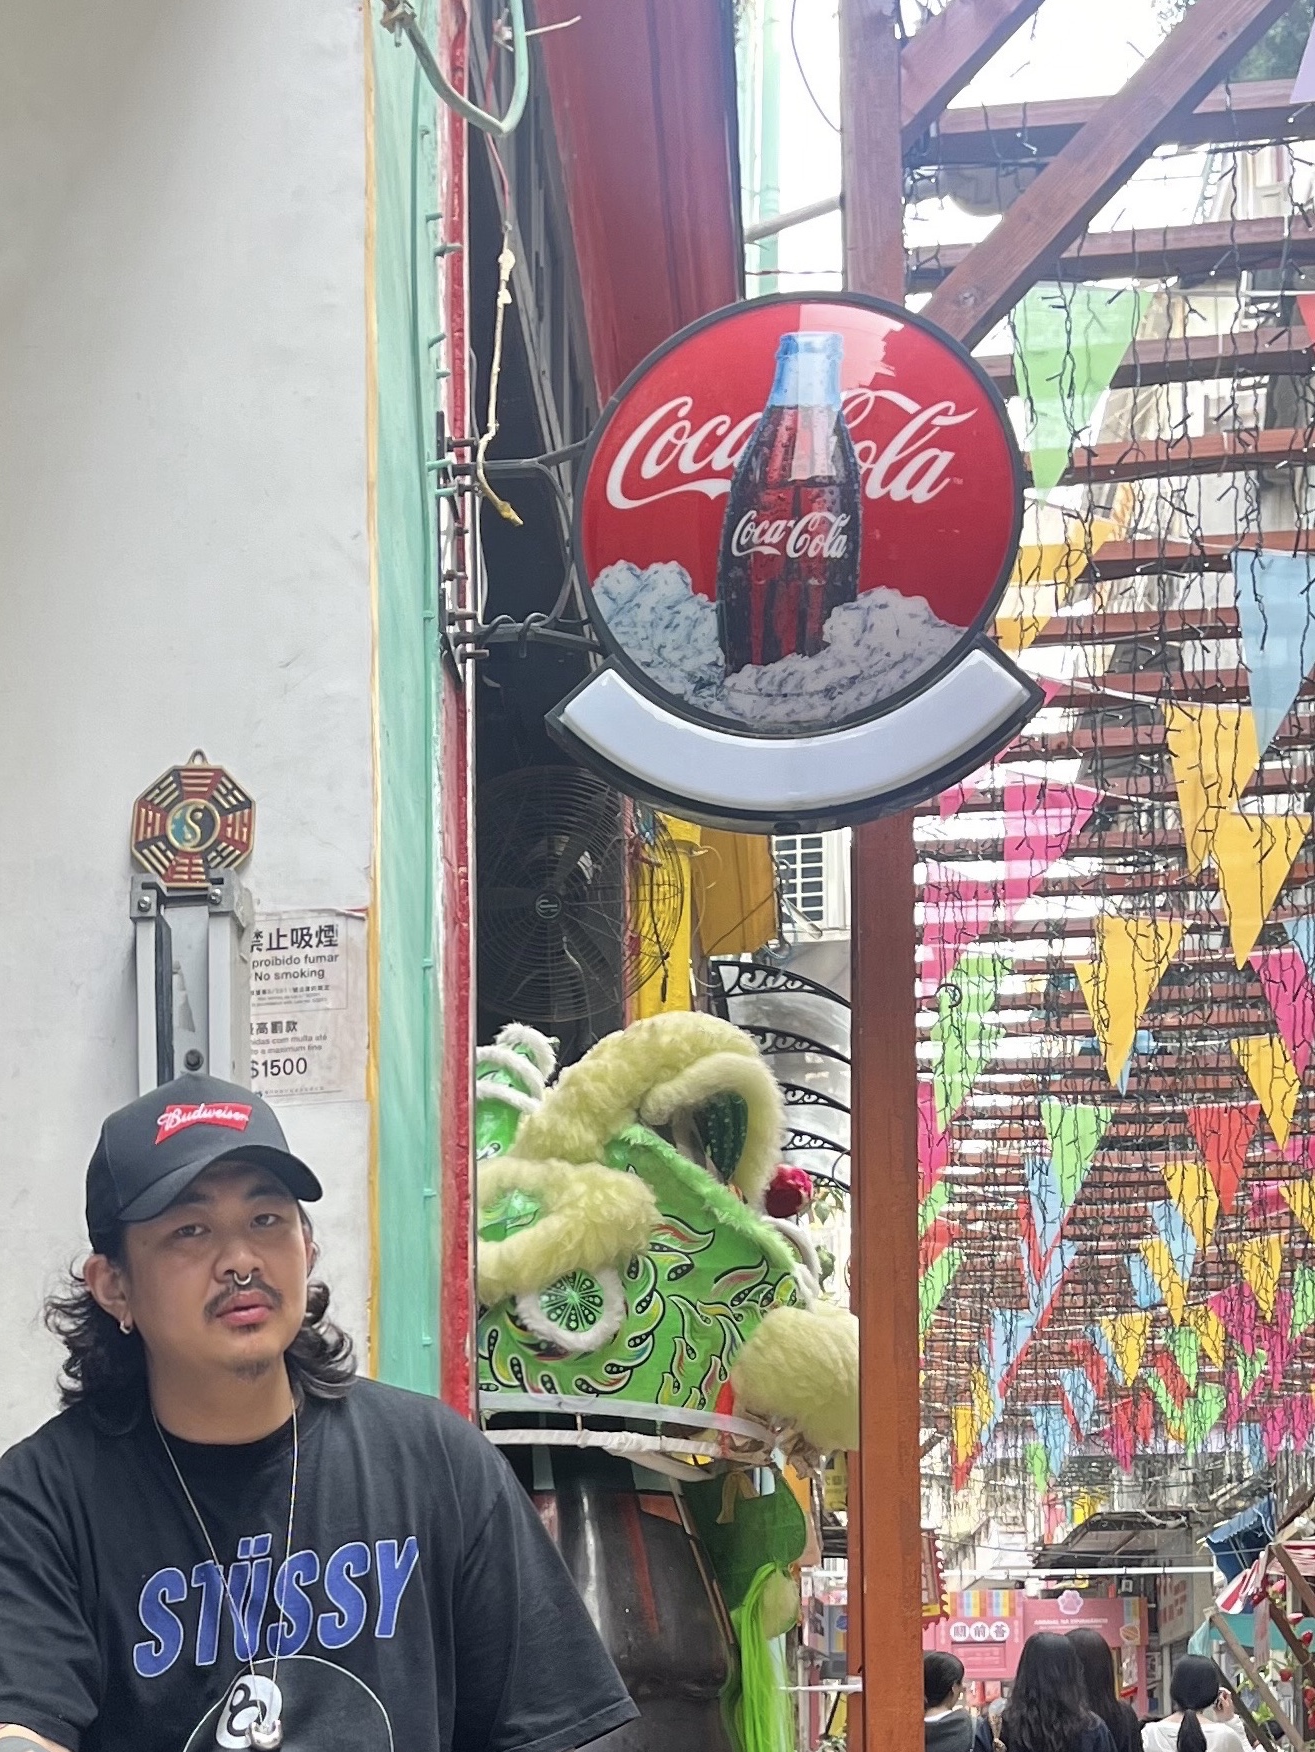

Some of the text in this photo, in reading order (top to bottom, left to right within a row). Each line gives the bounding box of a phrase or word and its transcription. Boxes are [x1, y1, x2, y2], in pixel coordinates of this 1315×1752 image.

[731, 510, 850, 559] Coca-Cola
[252, 953, 340, 969] proibido fumar
[254, 968, 325, 982] No smoking
[250, 1020, 298, 1035] 高罰款
[156, 1102, 250, 1132] Budweiser
[132, 1532, 420, 1678] STÜSSY
